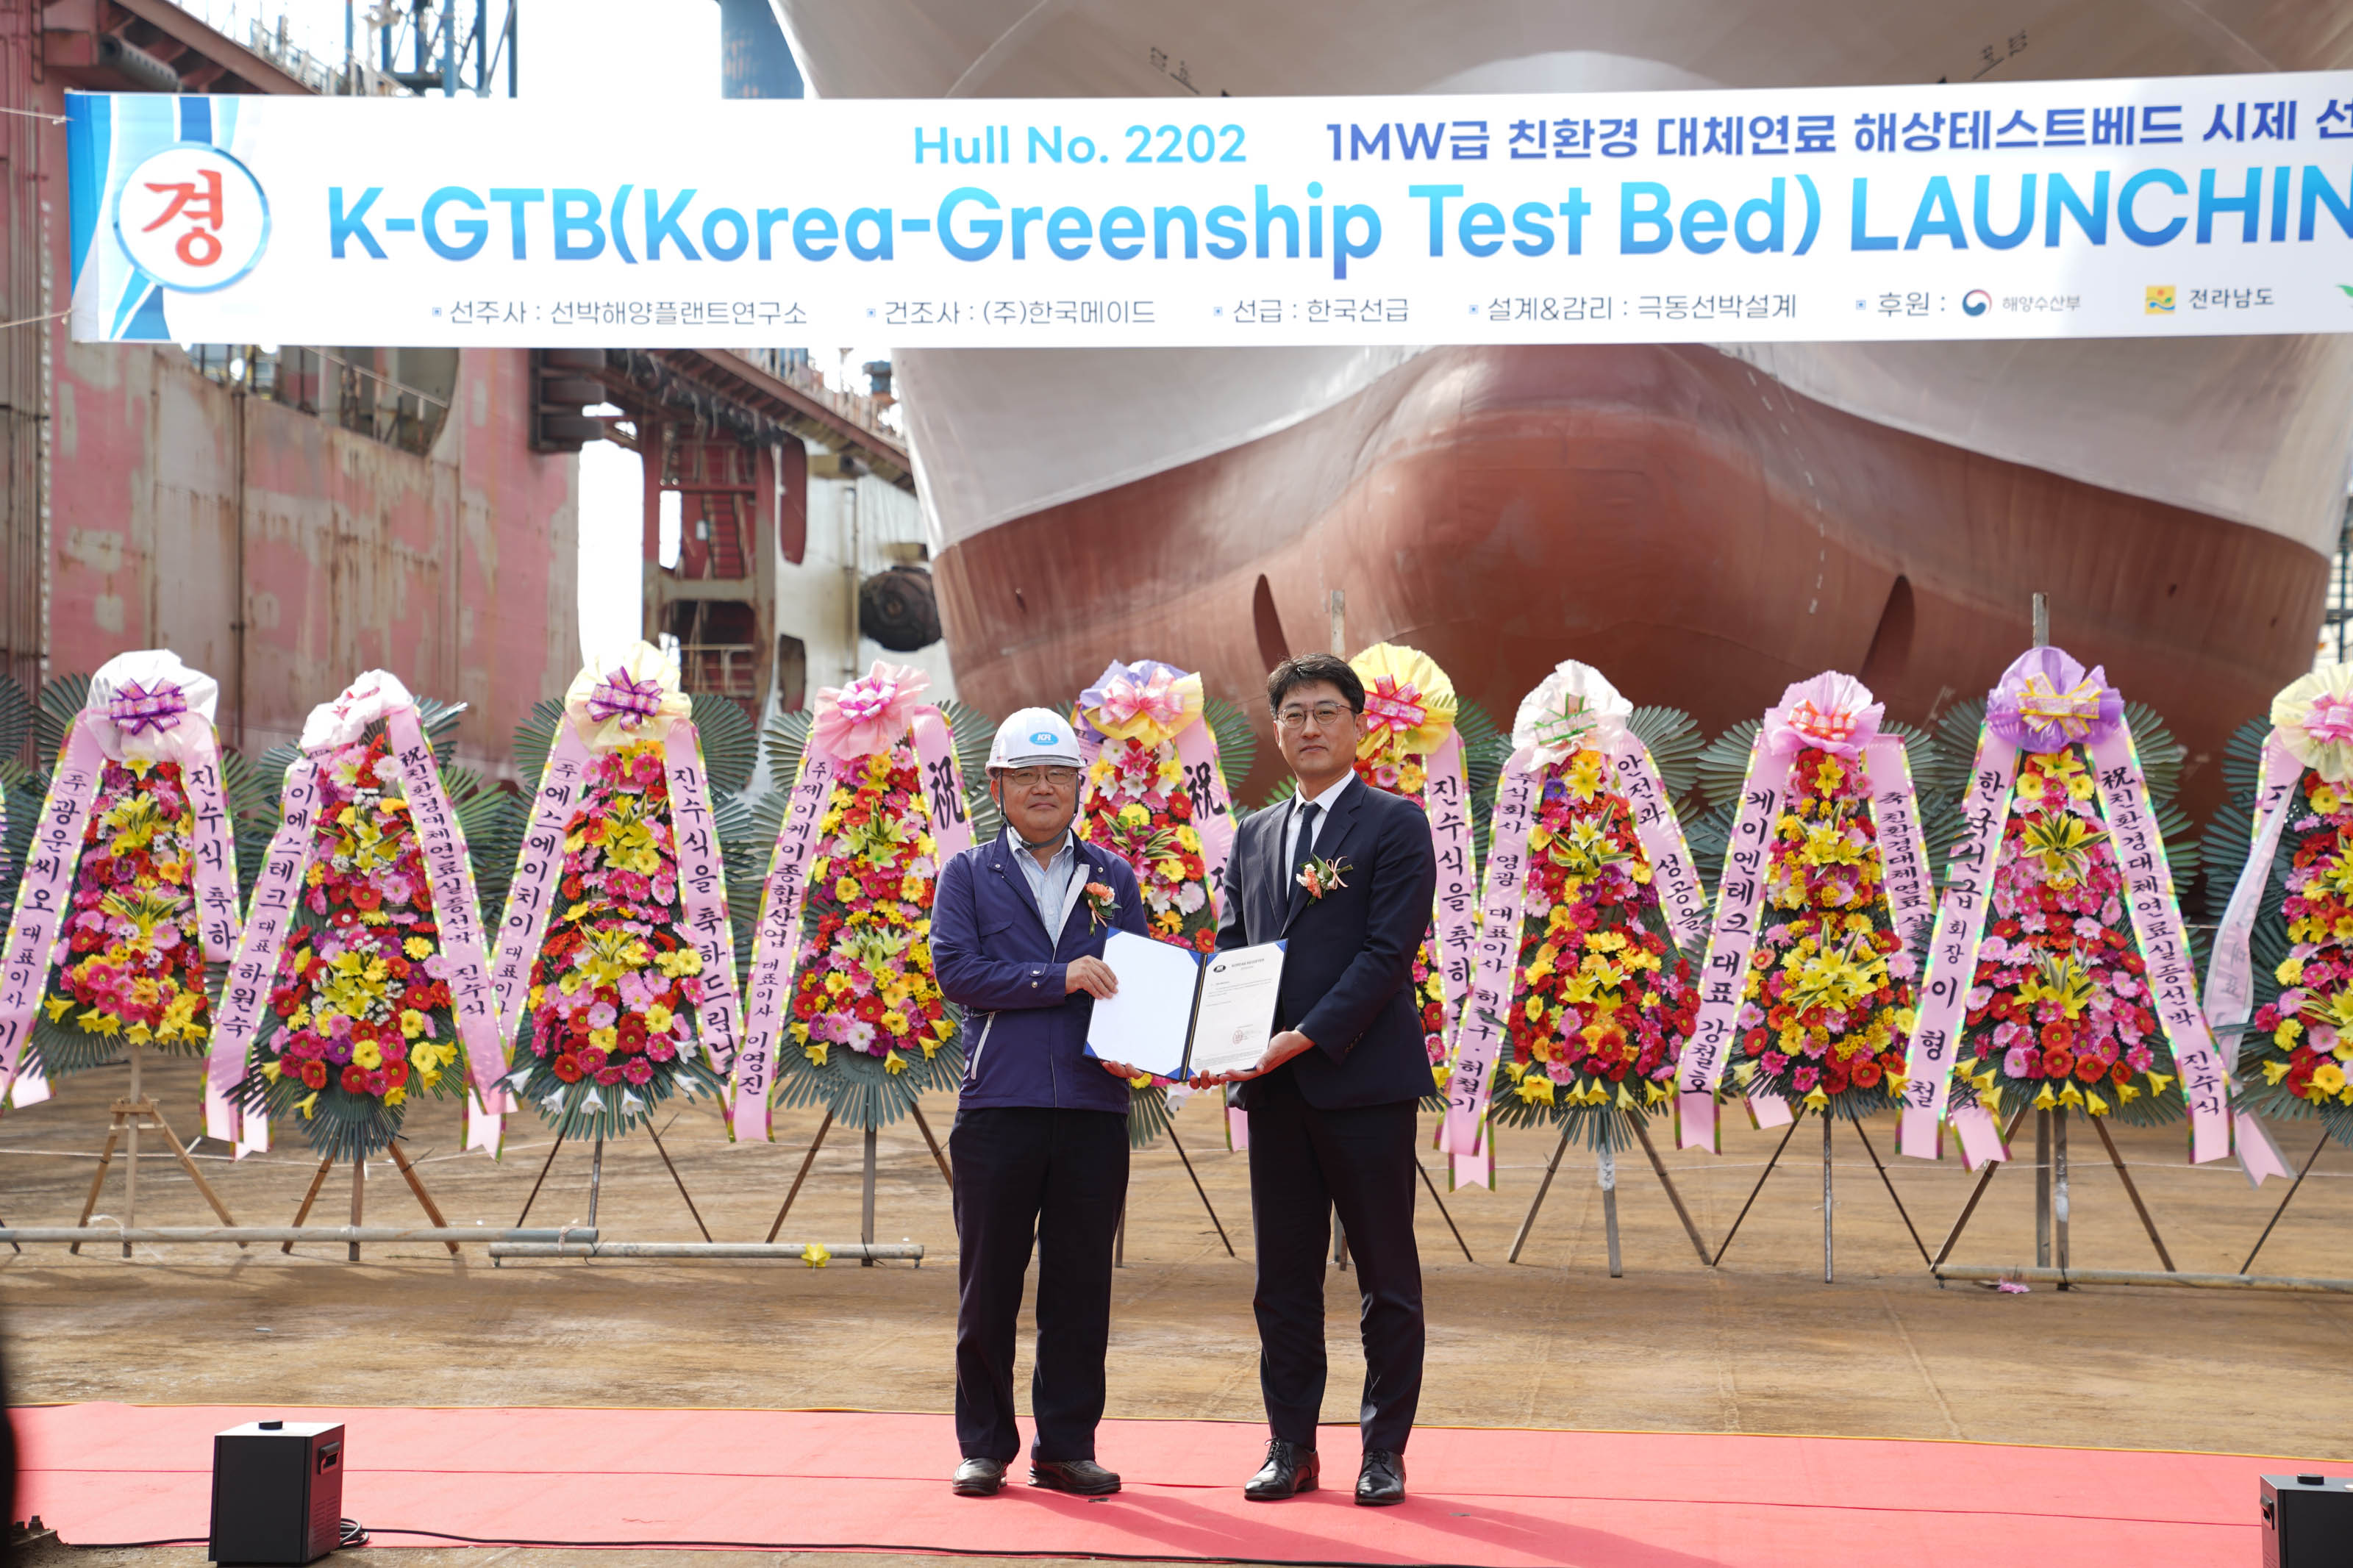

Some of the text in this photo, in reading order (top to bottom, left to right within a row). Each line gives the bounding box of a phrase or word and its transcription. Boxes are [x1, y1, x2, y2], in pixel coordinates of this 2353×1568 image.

[914, 123, 1247, 164] Hull No. 2202
[1327, 121, 1490, 162] 1MW급
[1508, 118, 1639, 160] 친환경
[1657, 115, 1837, 157] 대체연료
[1854, 105, 2184, 153] 해상테스트베드
[2202, 100, 2298, 142] 시제
[141, 169, 225, 268] 경
[328, 181, 1382, 280] K-GTB(Korea-Greenship
[1408, 184, 1592, 257] Test
[1619, 173, 1822, 257] Bed)
[449, 301, 527, 325] 선주사
[549, 300, 807, 325] 선박해양플랜트연구소
[885, 300, 960, 325] 건조사
[982, 299, 1156, 325] (주)한국메이드
[1233, 298, 1282, 323] 선급
[1307, 297, 1409, 323] 한국선급
[1488, 296, 1613, 321] 설계&감리
[1638, 293, 1796, 320] 극동선박설계
[1877, 290, 1930, 318] 후원
[2002, 294, 2081, 314] 해양수산부
[2188, 287, 2274, 311] 전라남도
[928, 755, 966, 831] 祝
[1184, 761, 1226, 820] 祝
[1497, 771, 1538, 836] 주식회사
[190, 765, 238, 951] 진수식 축하
[674, 766, 717, 894] 진수식을
[1432, 775, 1471, 912] 진수식을
[1618, 753, 1700, 931] 안전과 성공을
[1952, 771, 2005, 910] 한국선급
[1492, 853, 1520, 888] 영광
[5, 924, 41, 1010] 대표이사
[251, 919, 276, 954] 대표
[1478, 906, 1513, 974] 대표이사
[1680, 788, 1775, 1096] 케이엔테크 대표 강철호
[1943, 920, 1968, 964] 회장
[222, 962, 267, 1038] 하원수
[454, 964, 487, 1017] 진수식
[754, 959, 779, 1018] 대표이사
[736, 1031, 769, 1096] 이영진
[2183, 1050, 2220, 1116] 진수식
